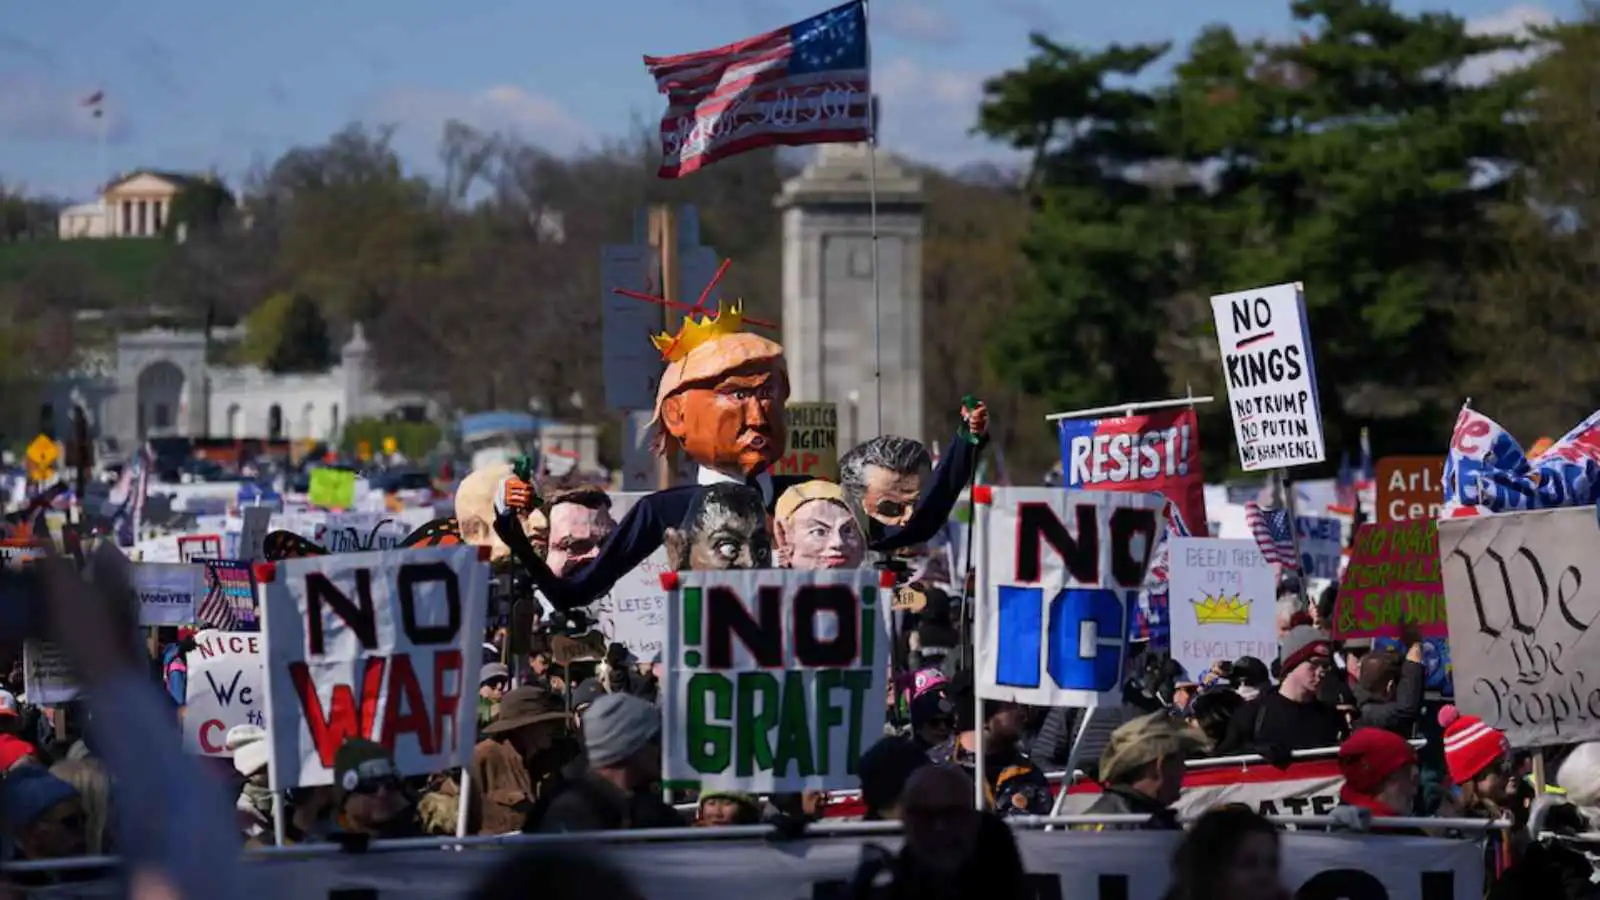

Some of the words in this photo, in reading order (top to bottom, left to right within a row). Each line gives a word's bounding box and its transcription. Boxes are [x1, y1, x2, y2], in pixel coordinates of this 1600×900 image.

[1231, 297, 1272, 333] NO
[1226, 344, 1301, 389] KINGS
[1235, 399, 1253, 416] NO
[1252, 390, 1308, 415] TRUMP
[791, 429, 836, 450] AGAIN
[1241, 422, 1258, 440] NO
[1262, 418, 1309, 438] PUTIN
[1070, 424, 1190, 486] RESIST!
[1241, 446, 1256, 463] NO
[1388, 468, 1440, 492] Arl.
[1015, 501, 1156, 588] NO
[305, 561, 461, 656] NO
[1446, 541, 1590, 642] We
[200, 636, 260, 660] NICE
[995, 584, 1138, 692] IC
[1510, 640, 1564, 685] the
[204, 669, 254, 706] We
[288, 650, 464, 769] WAR
[686, 668, 873, 778] GRAFT
